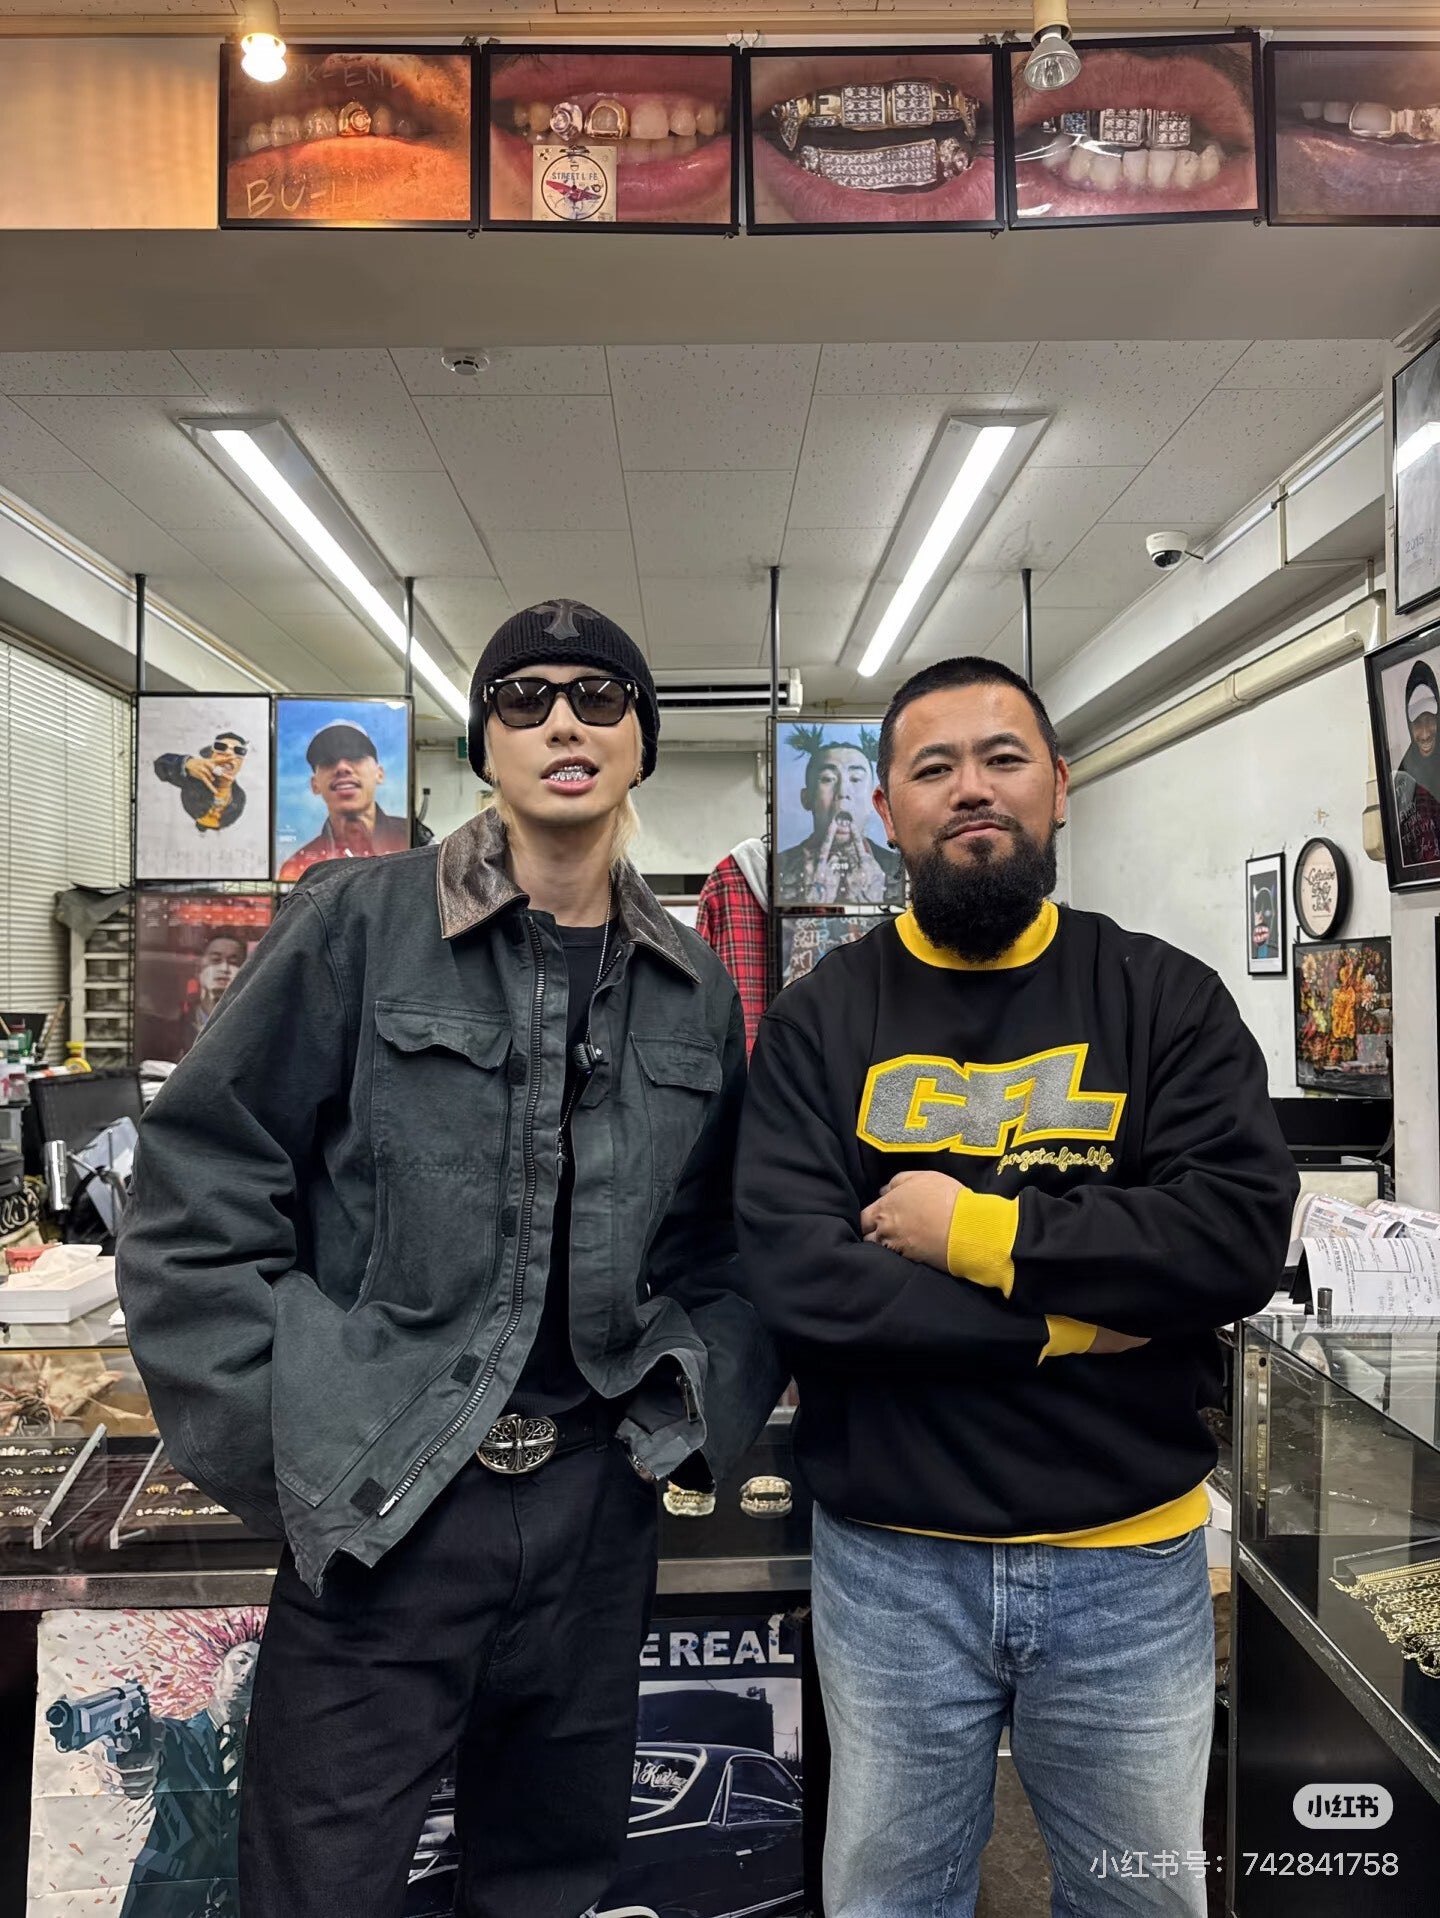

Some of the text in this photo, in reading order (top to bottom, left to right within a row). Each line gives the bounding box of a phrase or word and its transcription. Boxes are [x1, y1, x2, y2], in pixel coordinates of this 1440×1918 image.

[551, 172, 580, 181] STREET
[856, 1043, 1127, 1156] GFL
[669, 1613, 795, 1667] REAL
